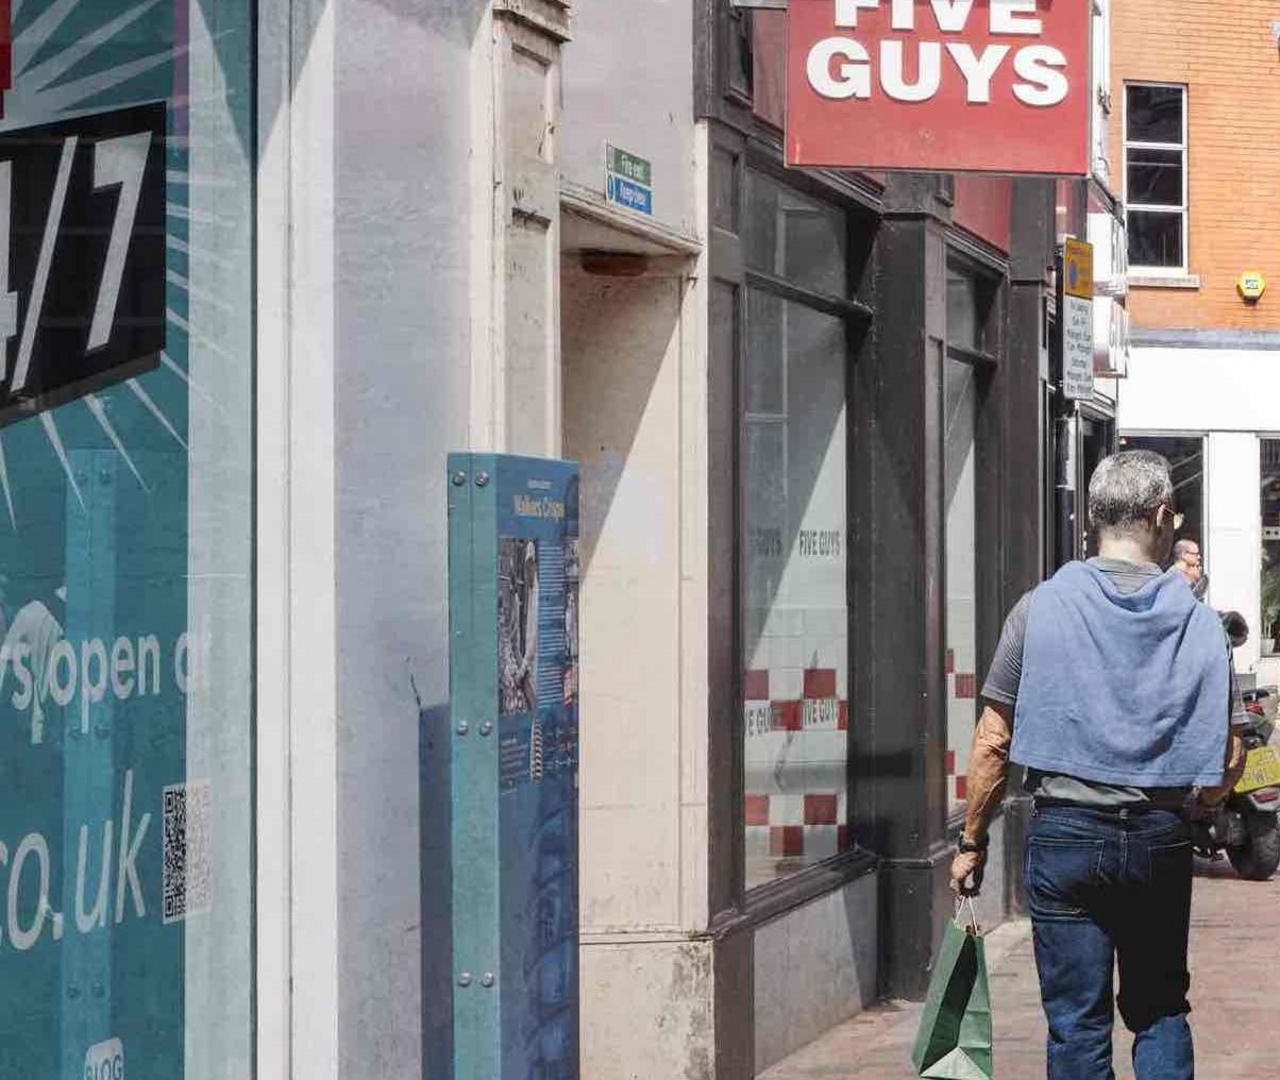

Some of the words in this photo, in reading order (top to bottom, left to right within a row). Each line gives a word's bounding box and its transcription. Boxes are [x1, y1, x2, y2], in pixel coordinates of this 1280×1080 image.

[805, 36, 1070, 107] GUYS
[800, 529, 818, 557] FIVE
[50, 633, 161, 735] open
[0, 769, 151, 951] o.uk
